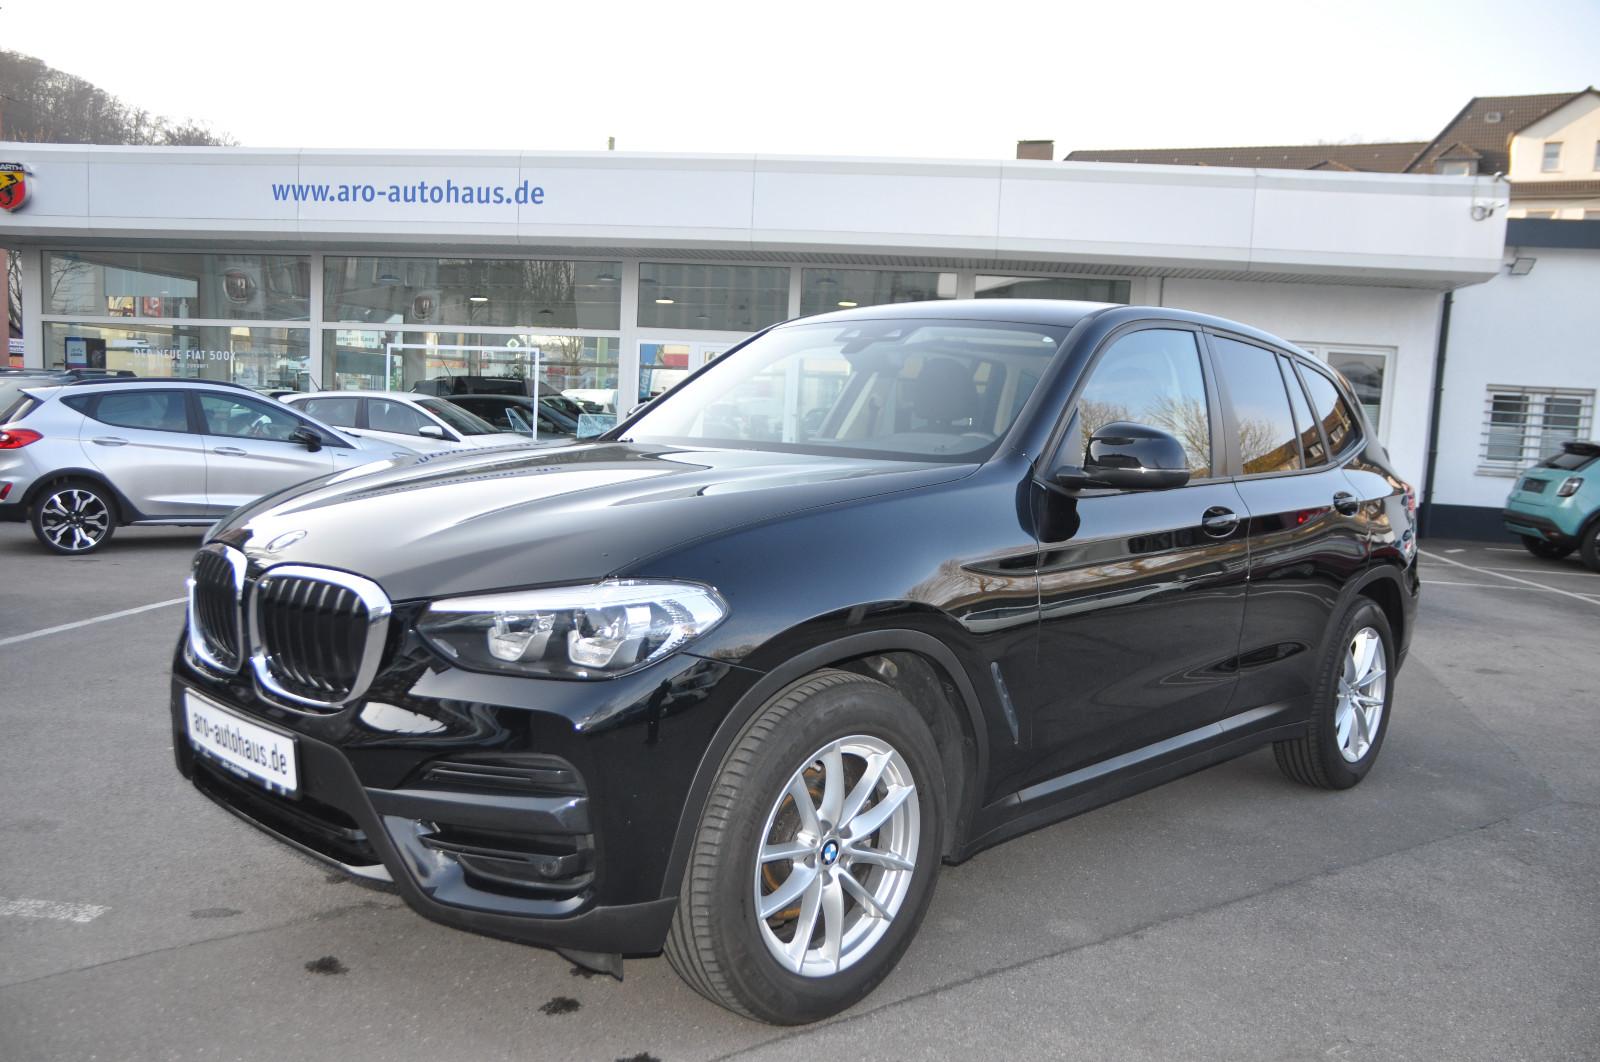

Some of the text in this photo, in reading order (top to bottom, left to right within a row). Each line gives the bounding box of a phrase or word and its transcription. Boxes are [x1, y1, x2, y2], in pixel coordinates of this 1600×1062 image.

[272, 179, 545, 205] www.aro-autohaus.de
[157, 349, 182, 360] NEUE
[186, 350, 206, 361] FIAT
[193, 712, 288, 775] aro-autohaus.de
